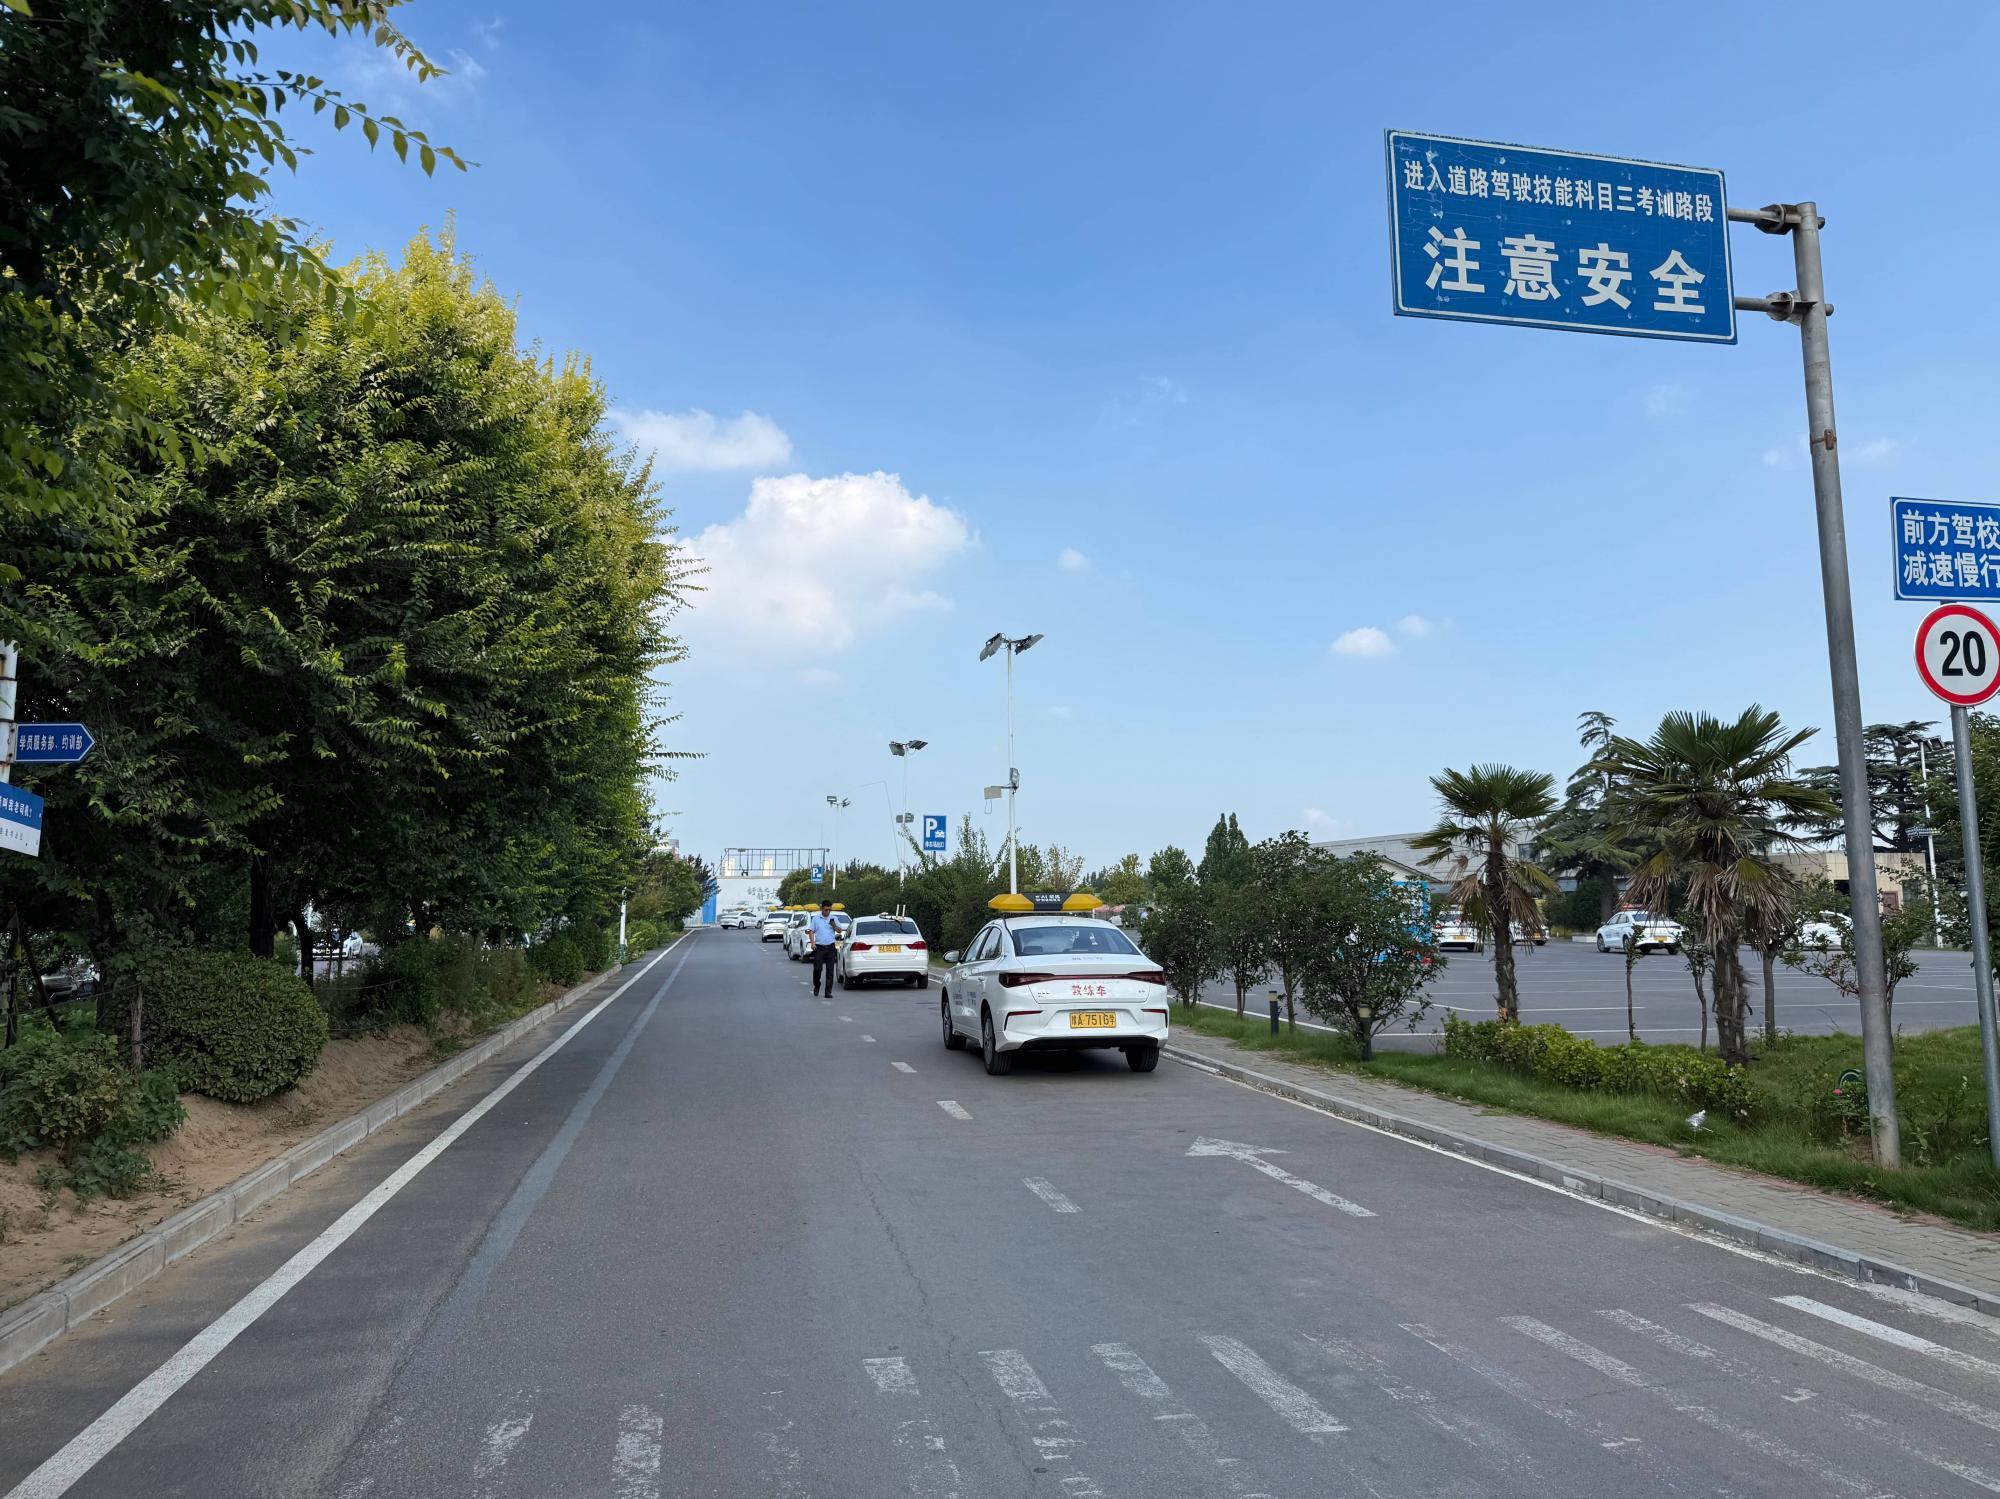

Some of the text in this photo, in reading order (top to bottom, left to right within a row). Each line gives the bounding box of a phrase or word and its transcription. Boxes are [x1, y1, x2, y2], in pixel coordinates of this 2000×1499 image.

[1403, 160, 1714, 223] 进入道路驾驶技能科目三考训路段
[1422, 225, 1706, 315] 注意安全
[1901, 509, 2000, 550] 前方驾校
[1903, 550, 2000, 589] 减速慢行
[1939, 630, 1986, 677] 20
[925, 817, 938, 838] P
[1071, 985, 1106, 996] 教练车
